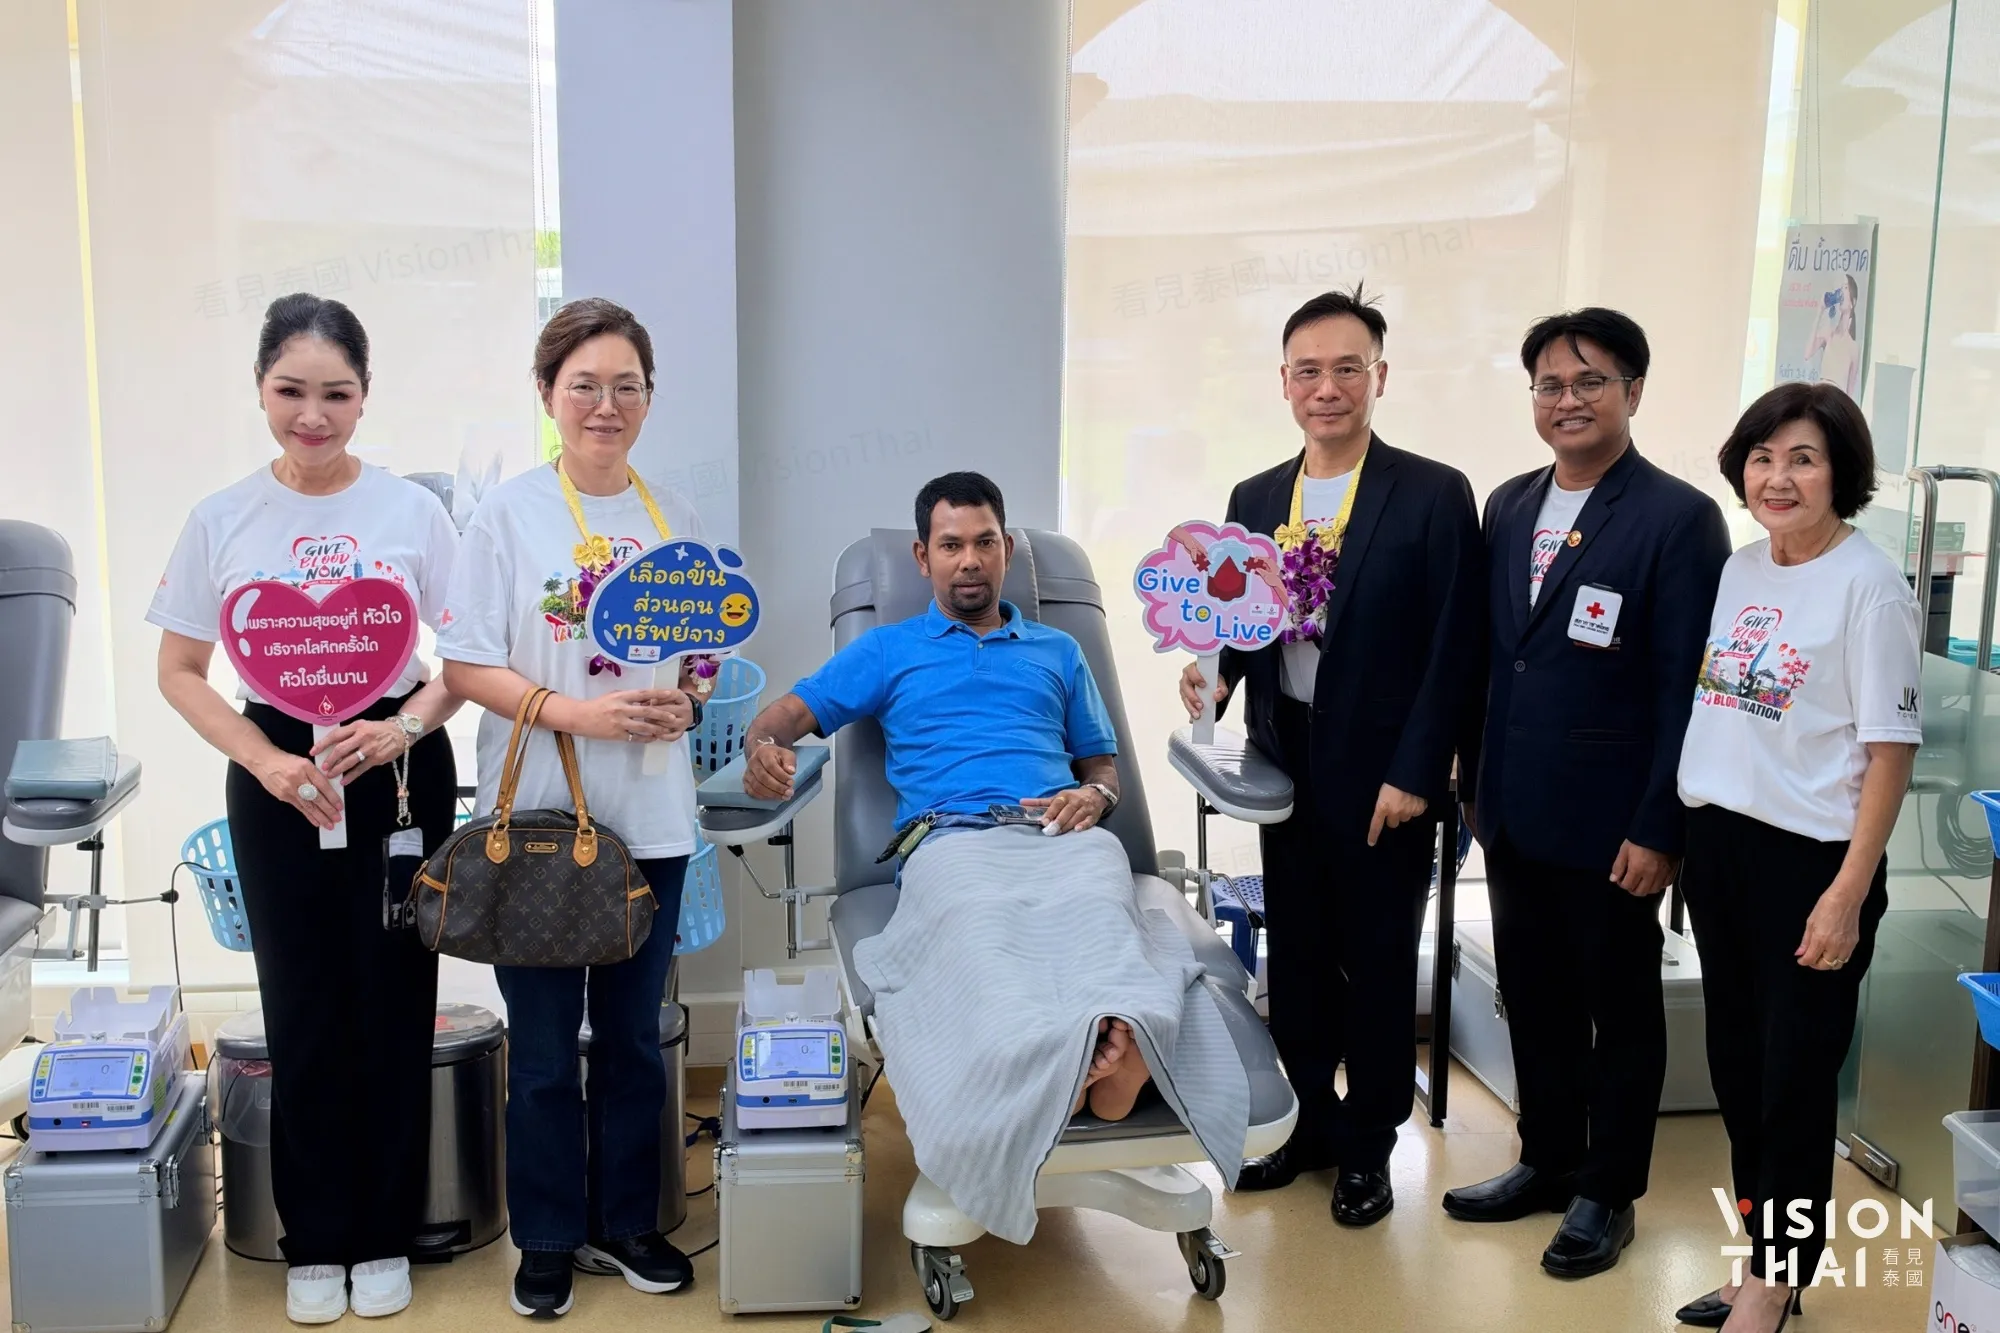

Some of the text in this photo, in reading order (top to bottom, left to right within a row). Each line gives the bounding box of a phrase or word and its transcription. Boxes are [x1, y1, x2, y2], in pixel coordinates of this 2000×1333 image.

[305, 542, 347, 556] GIVE
[613, 546, 633, 558] VE
[1539, 539, 1563, 551] GIV
[300, 553, 350, 568] BLOOD
[1532, 551, 1555, 563] BLO
[306, 565, 347, 580] NOW
[1138, 568, 1200, 593] Give
[634, 590, 714, 614] ส่วนคน
[1180, 598, 1211, 622] to
[363, 604, 402, 625] หัวใจ
[1743, 615, 1775, 629] GIVE
[613, 616, 726, 644] ทรัพย์จาง
[1215, 615, 1272, 640] Live
[1731, 626, 1768, 642] BLOOD
[264, 635, 379, 656] บริจาคโลหิตครั้งใด
[1728, 640, 1760, 653] NOW
[279, 665, 368, 688] หัวใจชื่นบาน
